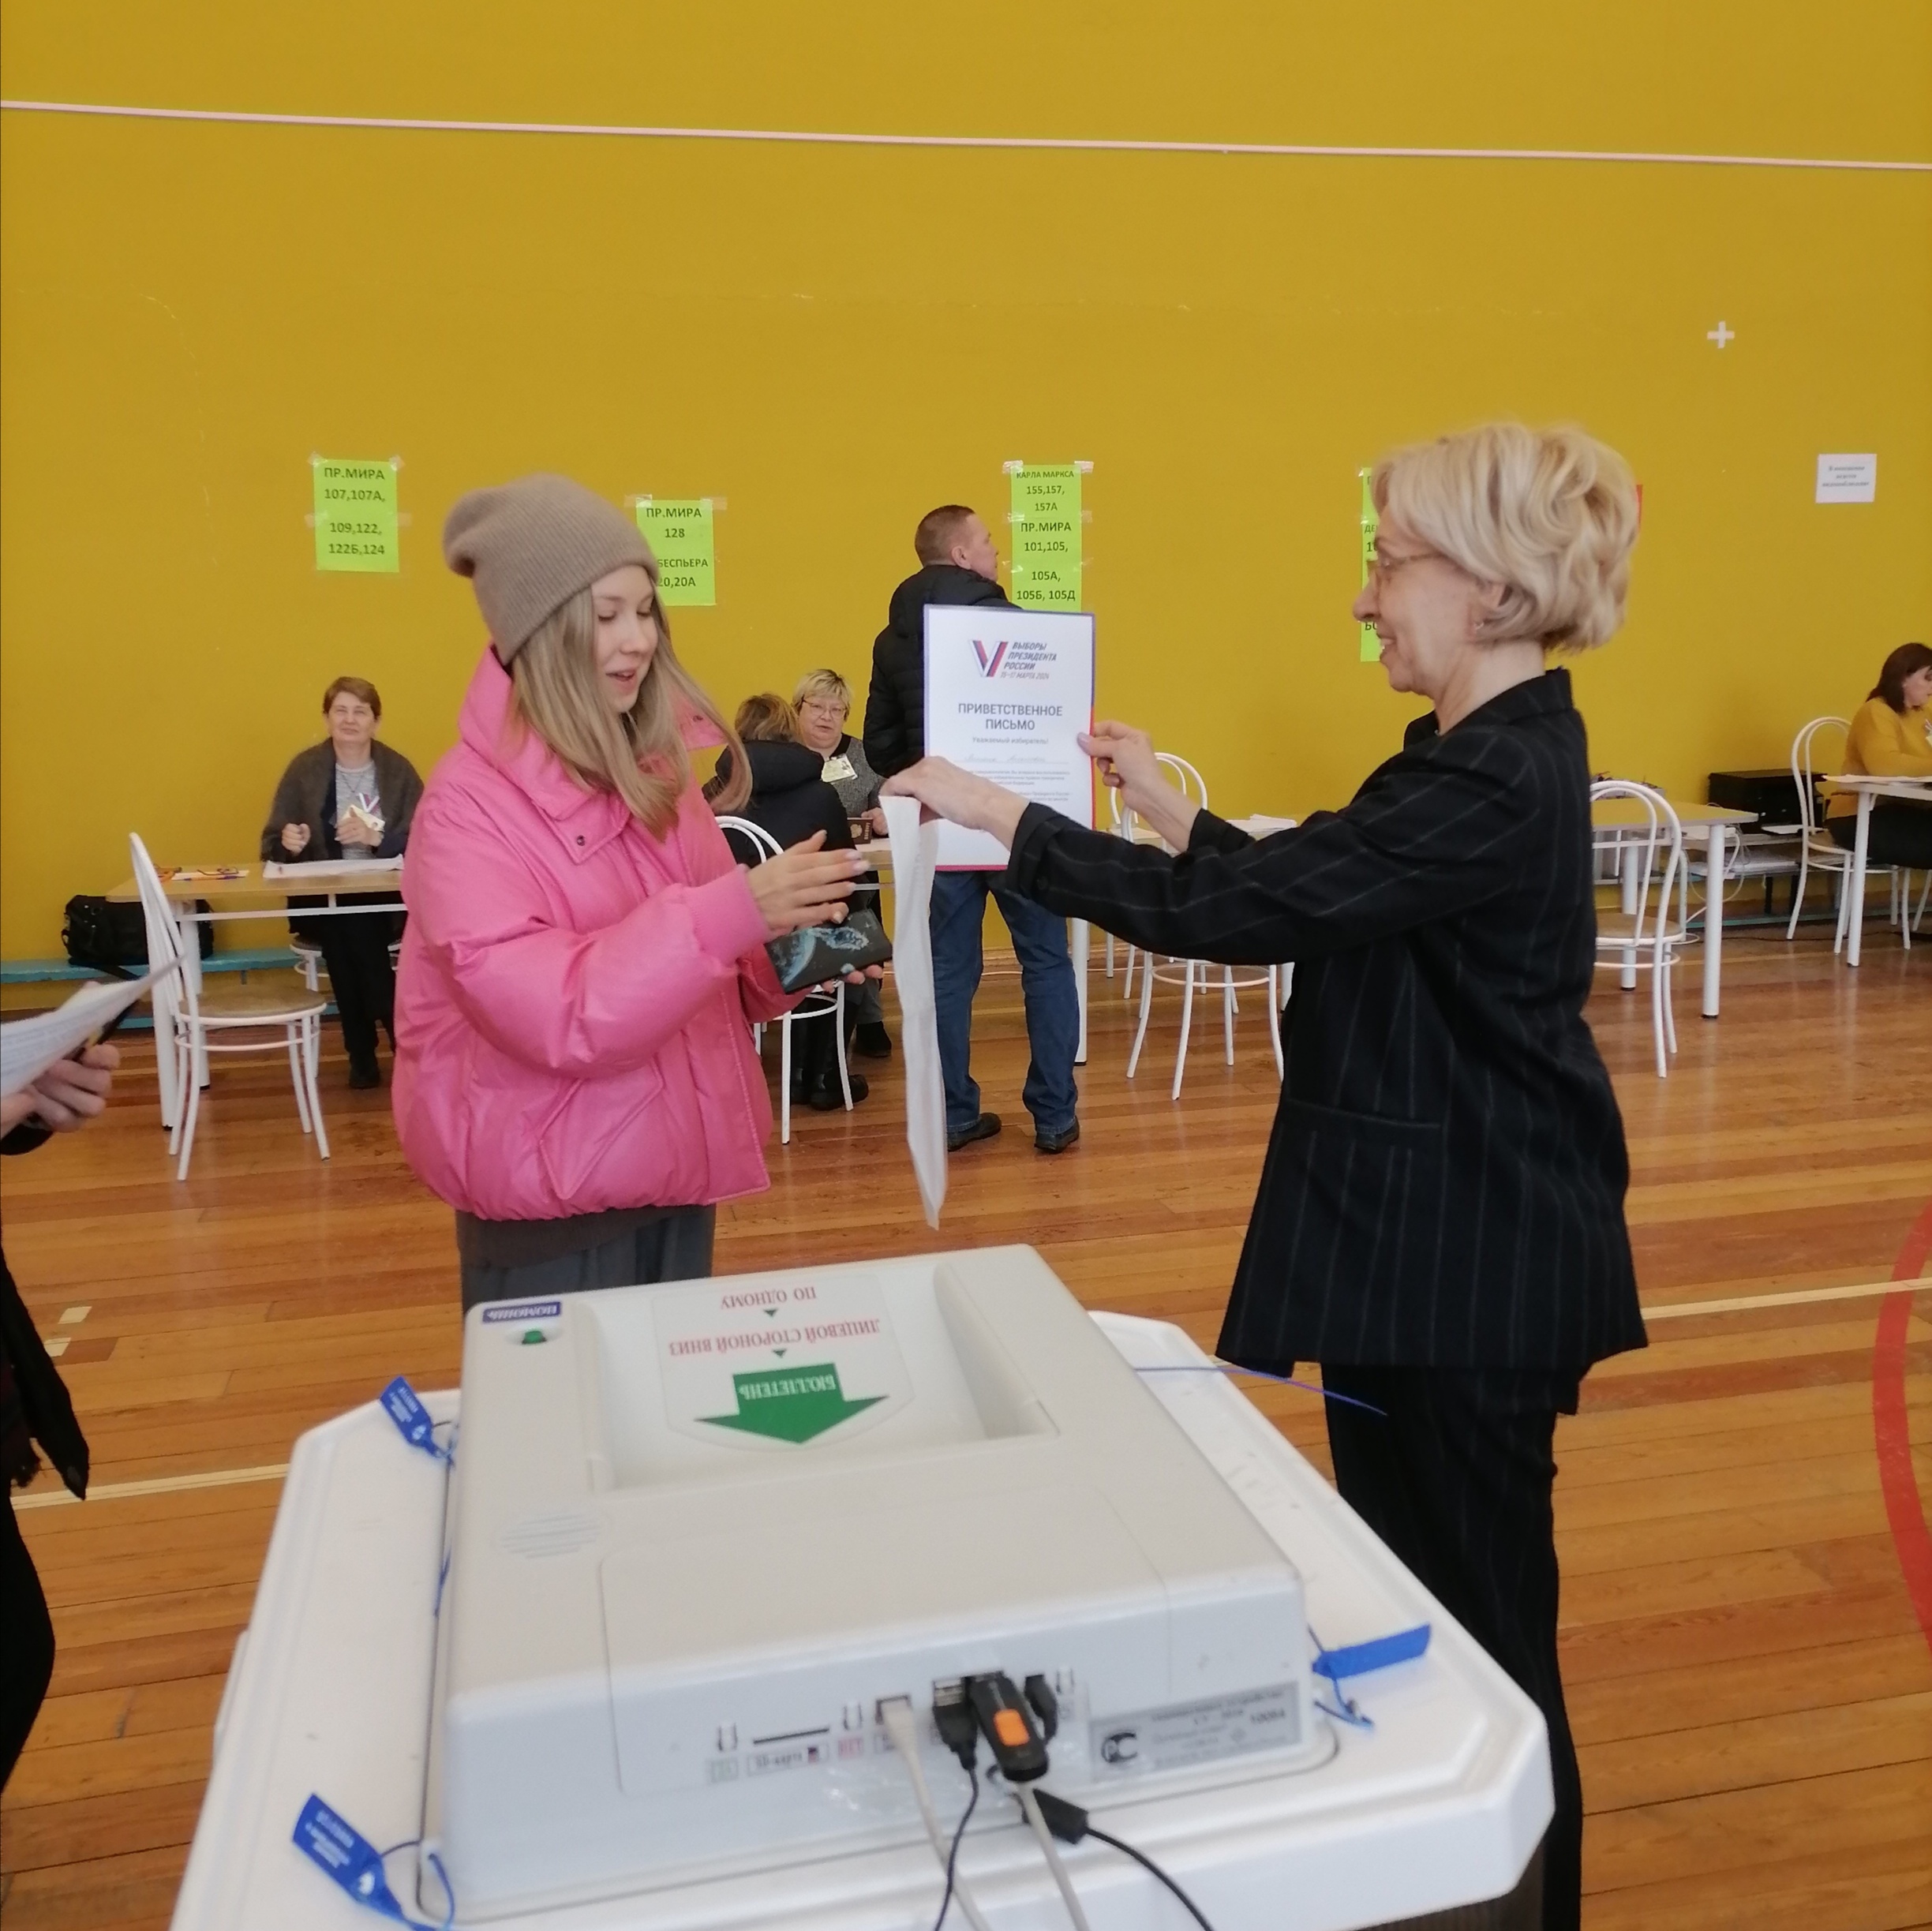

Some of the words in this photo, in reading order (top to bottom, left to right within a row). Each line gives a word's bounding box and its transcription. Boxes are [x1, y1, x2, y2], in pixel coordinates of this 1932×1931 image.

[324, 467, 385, 480] ПР.МИРА
[324, 488, 385, 502] 107,107А,
[1026, 485, 1065, 496] 155,157,
[1035, 503, 1058, 511] 157А
[646, 508, 702, 518] ПР.МИРА
[665, 528, 685, 538] 128
[1020, 522, 1072, 533] ПР.МИРА
[1024, 541, 1069, 553] 101,105,
[657, 559, 709, 568] БЕСПЬЕРА
[1032, 571, 1061, 582] 105А,
[1017, 590, 1046, 601] 105Б,
[1049, 590, 1076, 601] 105Д
[1013, 642, 1047, 650] ВЫБОРЫ
[1008, 652, 1057, 661] ПРЕЗИДЕНТА
[958, 703, 1063, 716] ПРИВЕТСТВЕННОЕ
[985, 719, 1035, 730] ПИСЬМО
[721, 1289, 788, 1309] ОДНОМУ
[794, 1286, 817, 1301] ПО
[807, 1319, 880, 1344] ЛИЦЕВОЙ
[717, 1329, 802, 1353] СТОРОНОЙ
[669, 1338, 712, 1357] ВНИЗ
[739, 1374, 837, 1401] БЮЛЛЕТЕНЬ
